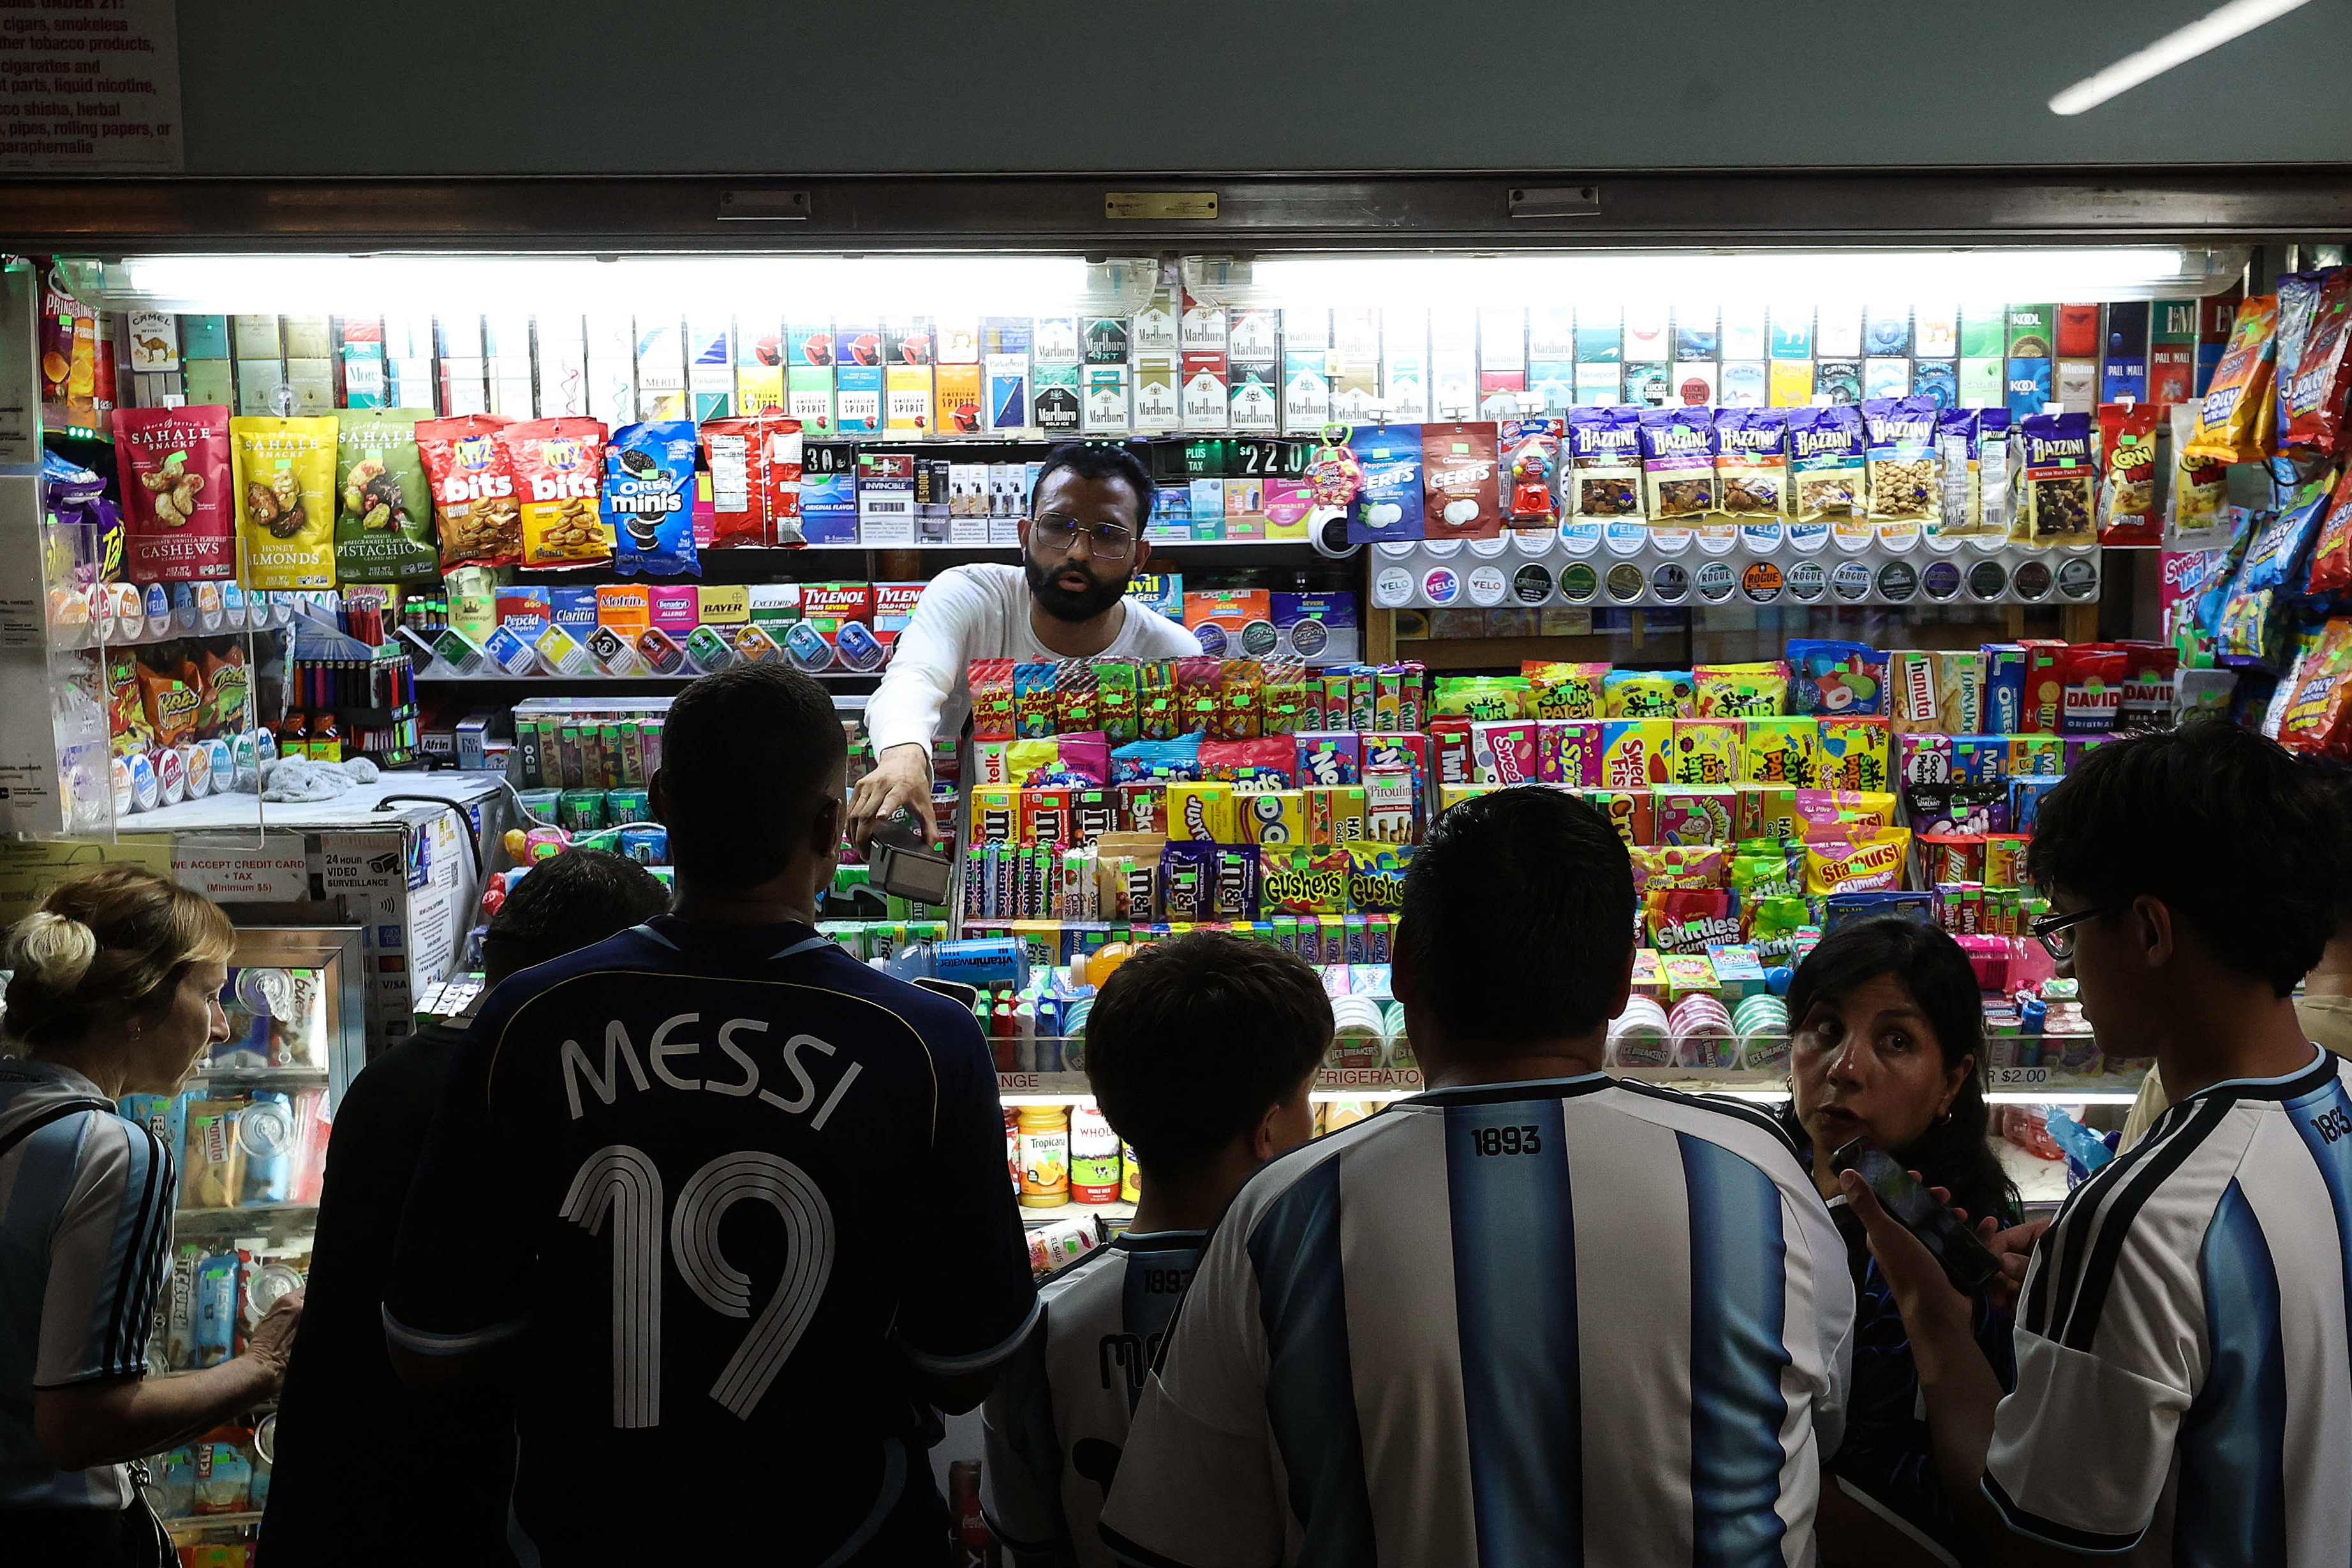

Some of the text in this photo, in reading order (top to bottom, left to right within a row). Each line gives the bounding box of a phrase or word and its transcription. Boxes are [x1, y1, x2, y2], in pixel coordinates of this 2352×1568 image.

[3, 17, 128, 33] cigars, smokeless
[30, 36, 154, 52] tobacco products,
[1, 59, 100, 76] cigarettes and
[11, 78, 156, 95] parts, liquid nicotine,
[24, 102, 120, 118] shisha, herbal
[9, 121, 170, 138] pipes, rolling papers, or
[132, 314, 171, 327] CAMEL
[2012, 313, 2041, 325] KOOL
[1139, 325, 1173, 341] Marlboro
[1185, 327, 1224, 342] Marlboro
[1086, 332, 1125, 352] Marlboro
[1232, 337, 1272, 355] Marlboro
[1534, 336, 1569, 353] Marlboro
[1039, 343, 1074, 358] Marlboro
[2155, 353, 2190, 363] PALL MALL
[349, 367, 378, 382] More
[1581, 371, 1616, 379] Newport
[1726, 369, 1762, 378] CAMEL
[1774, 366, 1809, 377] CAMEL
[1824, 365, 1856, 375] CAMEL
[1918, 363, 1953, 373] CAMEL
[2060, 363, 2095, 374] Winston
[2108, 366, 2143, 376] PALL MALL
[646, 378, 676, 387] MERIT
[693, 376, 728, 385] Parliament
[2011, 380, 2039, 392] KOOL
[1684, 385, 1706, 393] LUCKY
[942, 398, 975, 408] SPIRIT
[1187, 398, 1224, 415] Marlboro
[1289, 398, 1326, 414] Marlboro
[2203, 386, 2241, 413] JOLLY
[797, 405, 826, 413] SPIRIT
[845, 405, 875, 413] SPIRIT
[894, 404, 924, 413] SPIRIT
[1038, 403, 1076, 422] Marlboro
[1139, 399, 1173, 415] Marlboro
[1089, 406, 1123, 423] Marlboro
[1234, 406, 1275, 424] Marlboro
[131, 428, 211, 445] SAHALE
[339, 430, 415, 443] SAHALE
[1873, 420, 1930, 443] BAZZINI
[1982, 430, 2006, 440] BAZZINI
[149, 440, 197, 451] SNACKS
[246, 438, 320, 452] SAHALE
[353, 441, 398, 450] SNACKS
[1579, 428, 1636, 452] BAZZINI
[1653, 431, 1708, 455] BAZZINI
[1720, 428, 1776, 452] BAZZINI
[1796, 431, 1852, 455] BAZZINI
[1187, 448, 1206, 459] PLUS
[2034, 438, 2085, 462] BAZZINI
[2111, 447, 2154, 469] CORN
[1188, 461, 1203, 471] TAX
[1363, 461, 1404, 470] Peppermint
[1430, 465, 1491, 488] CERTS
[445, 474, 513, 503] bits
[531, 475, 598, 501] bits
[619, 480, 672, 495] OREO
[612, 492, 683, 513] minis
[140, 543, 219, 558] CASHEWS
[262, 544, 295, 552] HONEY
[337, 543, 426, 558] PISTACHIOS
[1702, 572, 1730, 582] ROGUE
[1748, 573, 1779, 584] ROGUE
[1793, 572, 1823, 581] ROGUE
[1839, 572, 1867, 581] ROGUE
[1380, 581, 1409, 590] VELO
[1428, 579, 1456, 593] VELO
[1472, 581, 1501, 590] VELO
[201, 597, 218, 610] VELO
[225, 596, 242, 607] VELO
[600, 593, 642, 608] Motrin
[753, 600, 796, 608] EXCEDRIN
[804, 589, 865, 605] TYLENOL
[122, 600, 139, 614] VELO
[147, 599, 166, 610] VELO
[657, 600, 690, 609] Benadryl
[704, 603, 742, 613] BAYER
[504, 614, 540, 628] Pepcid
[556, 609, 595, 623] Claritin
[1911, 661, 1930, 721] hanuta
[2301, 677, 2336, 697] JOLLY
[1542, 690, 1589, 704] SOUR
[2067, 690, 2121, 708] DAVID
[1539, 702, 1594, 719] PATCH
[1715, 703, 1775, 717] SOUR
[2039, 702, 2057, 728] RITZ
[425, 740, 448, 750] Afrin
[164, 764, 180, 780] VELO
[171, 860, 304, 869] WE ACCEPT CREDIT CARD
[326, 854, 339, 864] 24
[233, 872, 253, 880] TAX
[327, 868, 357, 876] VIDEO
[207, 883, 272, 893] (Minimum $5)
[328, 878, 388, 888] SURVEILLANCE
[1022, 856, 1032, 915] mentos
[1266, 868, 1342, 905] Gushers
[1835, 870, 1895, 892] Gummies
[1677, 934, 1740, 955] Gummies
[938, 956, 1013, 968] vitaminwater
[383, 981, 406, 990] VISA
[1332, 1049, 1343, 1060] ICE
[561, 1013, 862, 1131] MESSI
[2002, 1070, 2046, 1083] $2.00
[1031, 1138, 1065, 1149] Tropicana
[1471, 1125, 1541, 1157] 1893
[558, 1144, 836, 1428] 19
